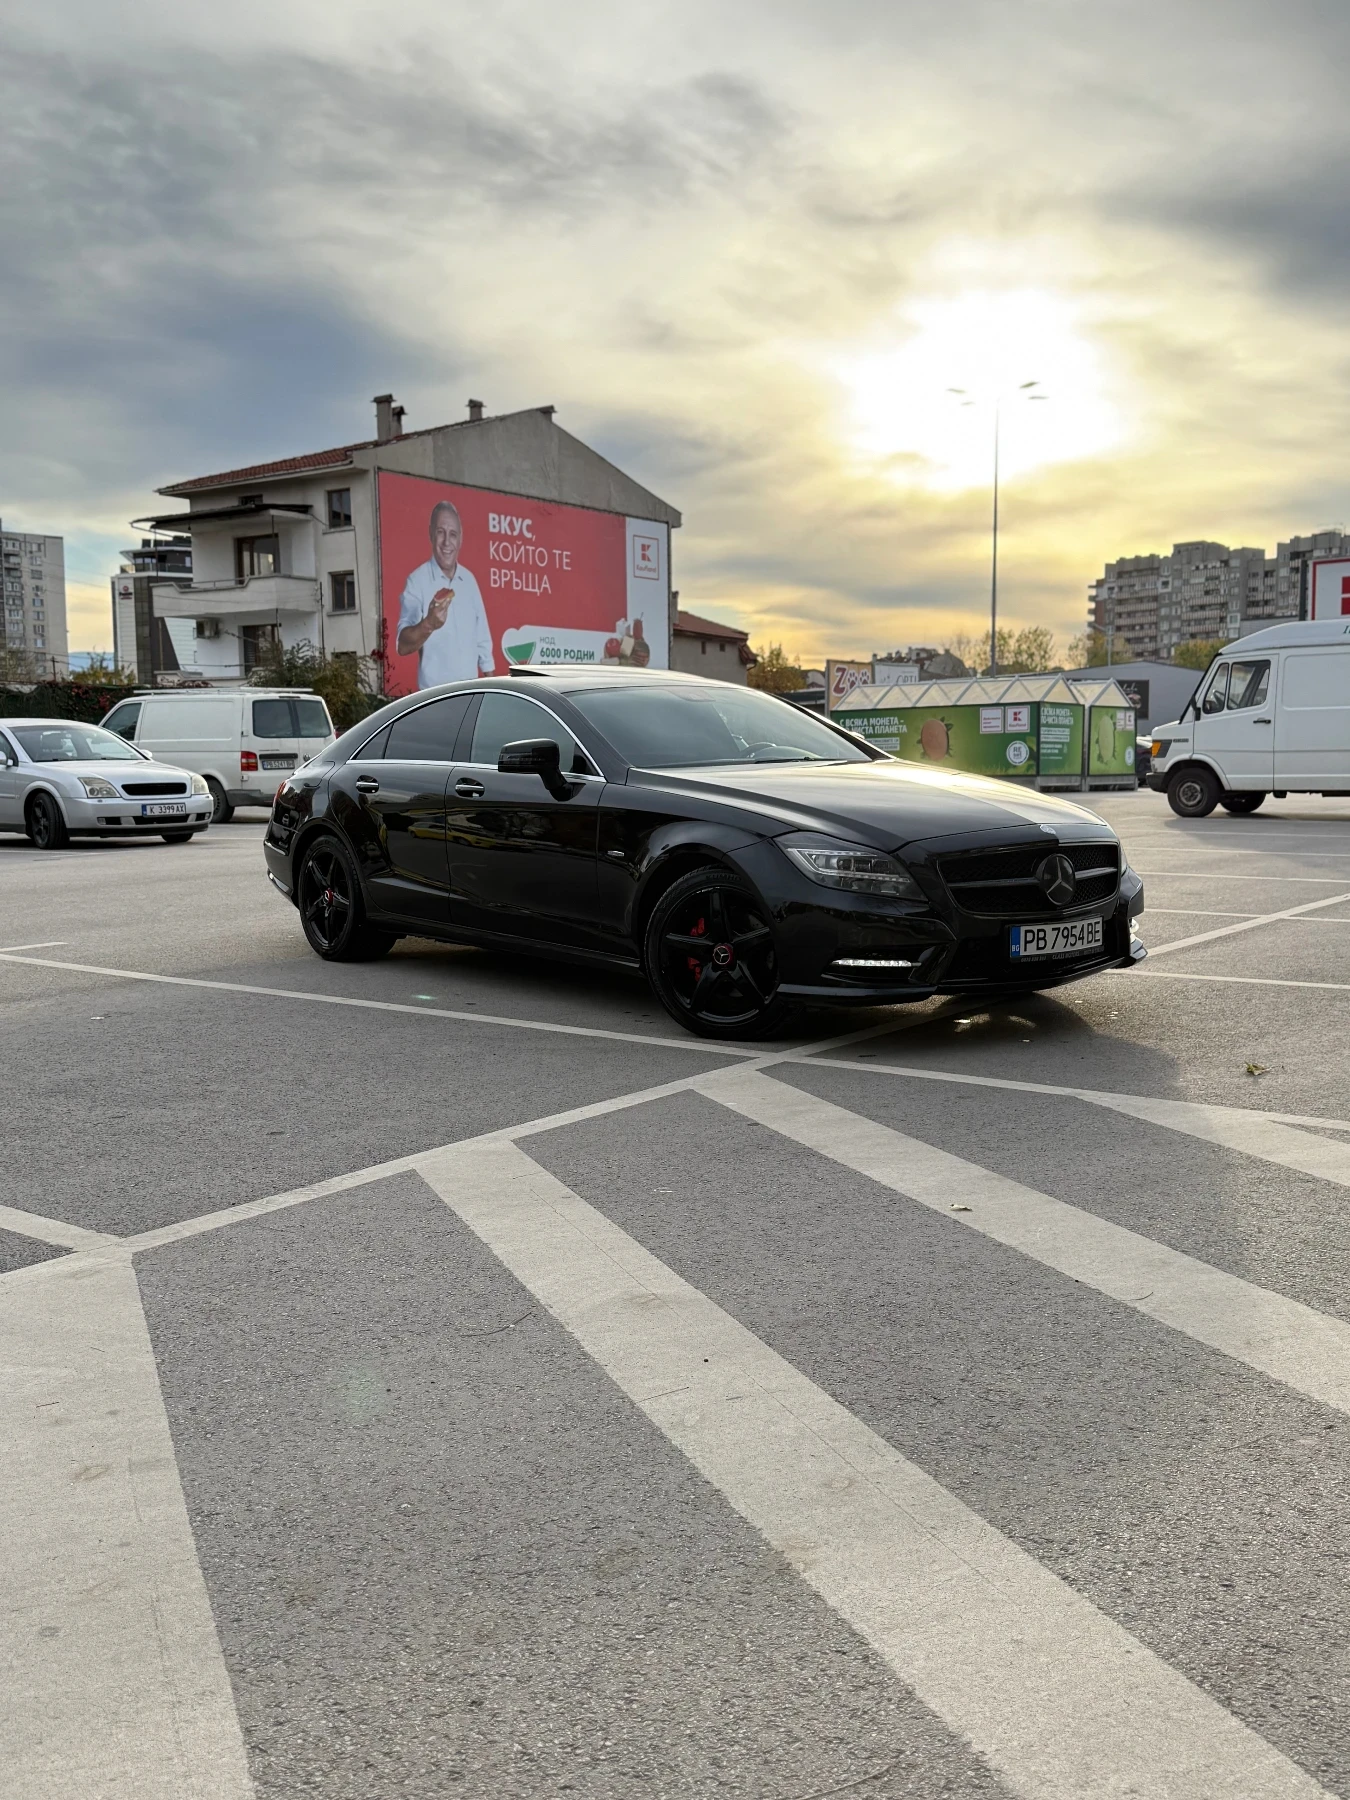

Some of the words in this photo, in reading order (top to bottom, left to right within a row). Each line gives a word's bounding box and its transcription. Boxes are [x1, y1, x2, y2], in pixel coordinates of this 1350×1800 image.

[488, 512, 536, 542] ВКУС,
[489, 538, 548, 567] КОЙТО
[552, 549, 572, 570] ТЕ
[490, 567, 552, 596] ВРЪЩА
[540, 647, 561, 658] 6000
[563, 648, 595, 662] РОДНИ
[839, 718, 845, 727] С
[845, 718, 869, 727] ВСЯКА
[869, 716, 899, 726] МОНЕТА
[874, 724, 908, 734] ПЛАНЕТА
[149, 806, 155, 814] K
[158, 805, 175, 814] 3399
[175, 804, 185, 813] AX
[1024, 928, 1047, 952] PB
[1051, 924, 1085, 950] 7954
[1086, 920, 1100, 945] BE
[1012, 944, 1020, 952] BG
